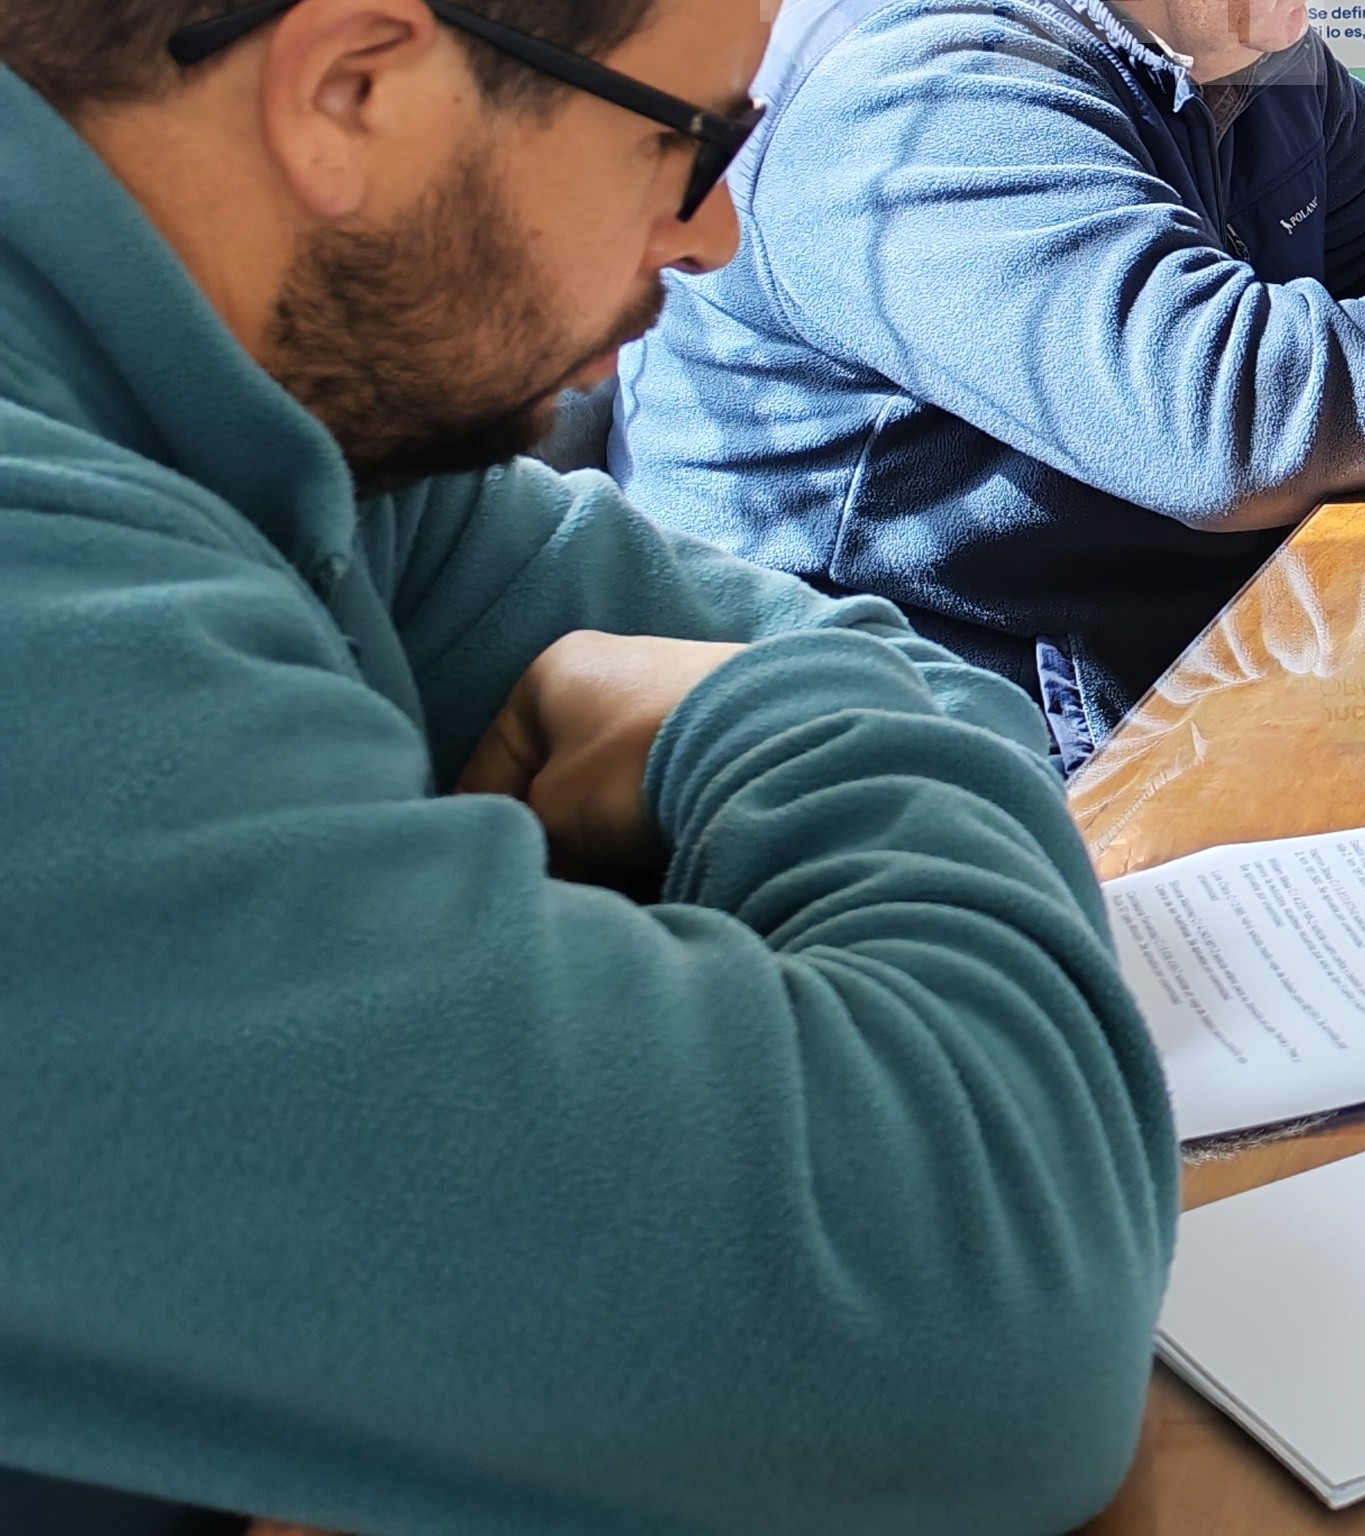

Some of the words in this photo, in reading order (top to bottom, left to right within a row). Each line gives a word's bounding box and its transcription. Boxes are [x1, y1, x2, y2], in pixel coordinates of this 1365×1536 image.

[1308, 7, 1328, 20] Se
[1326, 25, 1341, 39] lo
[1344, 27, 1365, 40] es,
